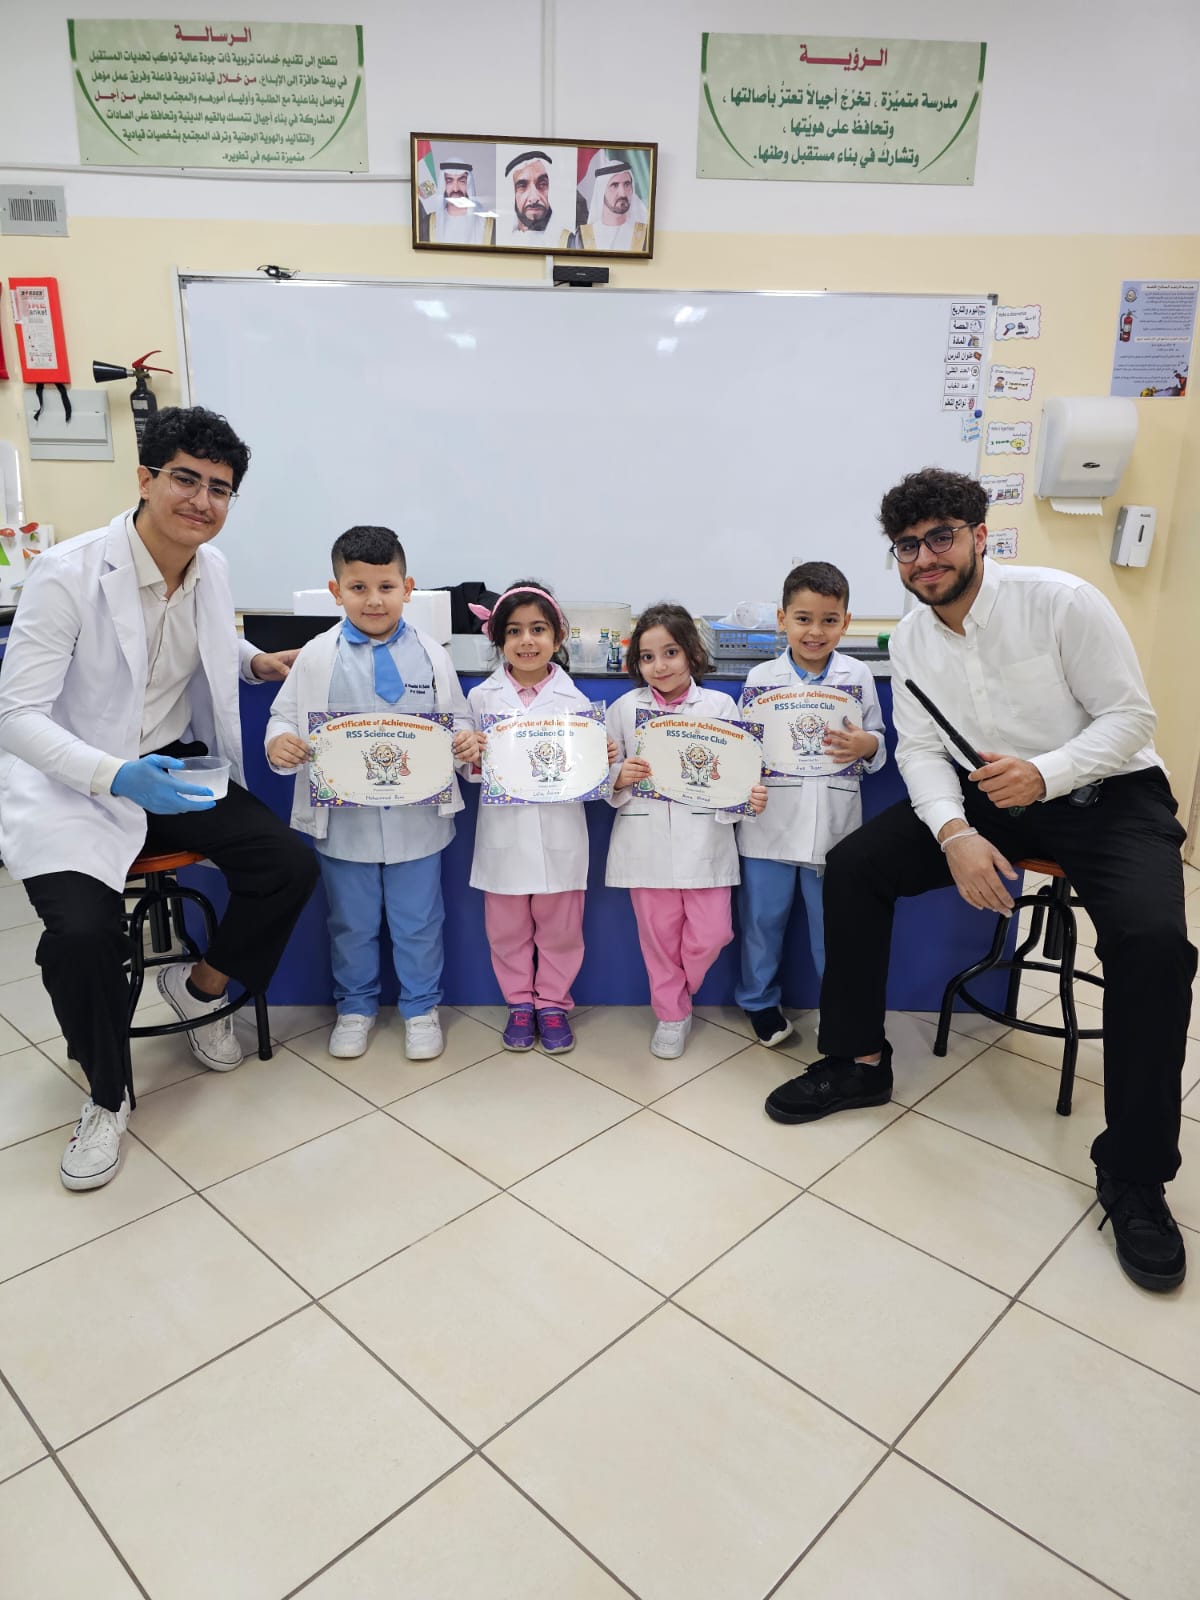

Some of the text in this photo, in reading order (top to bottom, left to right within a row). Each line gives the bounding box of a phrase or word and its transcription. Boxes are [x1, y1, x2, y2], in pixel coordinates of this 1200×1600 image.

[174, 24, 251, 46] الرسالة
[89, 49, 122, 63] المستقبل
[123, 50, 151, 63] تحديات
[152, 51, 178, 64] تواكب
[179, 52, 198, 64] عالية
[199, 52, 216, 65] جودة
[217, 52, 231, 63] ذات
[231, 52, 255, 65] تربوية
[256, 53, 281, 65] خدمات
[282, 54, 303, 67] تقديم
[304, 55, 316, 67] إلى
[799, 43, 888, 72] الرؤية
[91, 70, 110, 83] مؤهل
[111, 70, 129, 83] عمل
[130, 70, 151, 83] وفريق
[150, 70, 173, 83] فاعلة
[173, 71, 197, 84] تربوية
[197, 71, 216, 85] قيادة
[216, 72, 243, 85] خلال
[244, 73, 257, 86] من
[286, 74, 298, 87] إلى
[299, 74, 319, 87] حافزة
[320, 74, 337, 88] بيئة
[337, 75, 347, 89] في
[94, 88, 345, 108] يتواصل بفاعلية مع الطلبة وأولياء أمورهم والمجتمع المحلي من أجل
[730, 85, 777, 107] بأصالتها
[921, 92, 958, 112] مدرسة
[106, 108, 335, 127] المشاركة في بناء أجيال تتمسك بالقيم الدينية وتحافظ على العادات
[826, 119, 850, 138] على
[122, 128, 315, 146] والتقاليد والهوية الوطنية وترفد المجتمع بشخصيات قيادية
[250, 150, 262, 164] في
[261, 151, 281, 163] تسهم
[280, 151, 305, 164] متميزة
[791, 145, 836, 165] مستقبل
[837, 147, 859, 167] بناء
[859, 147, 877, 169] في
[757, 692, 797, 705] Certificate
[806, 690, 848, 703] Achievement
[774, 702, 836, 711] RSS Science Club
[326, 719, 371, 731] Certificate
[381, 718, 434, 732] Achievement
[650, 719, 745, 740] Certificate of Achievement
[346, 730, 416, 739] RSS Science Club
[666, 729, 728, 745] RSS Science Club
